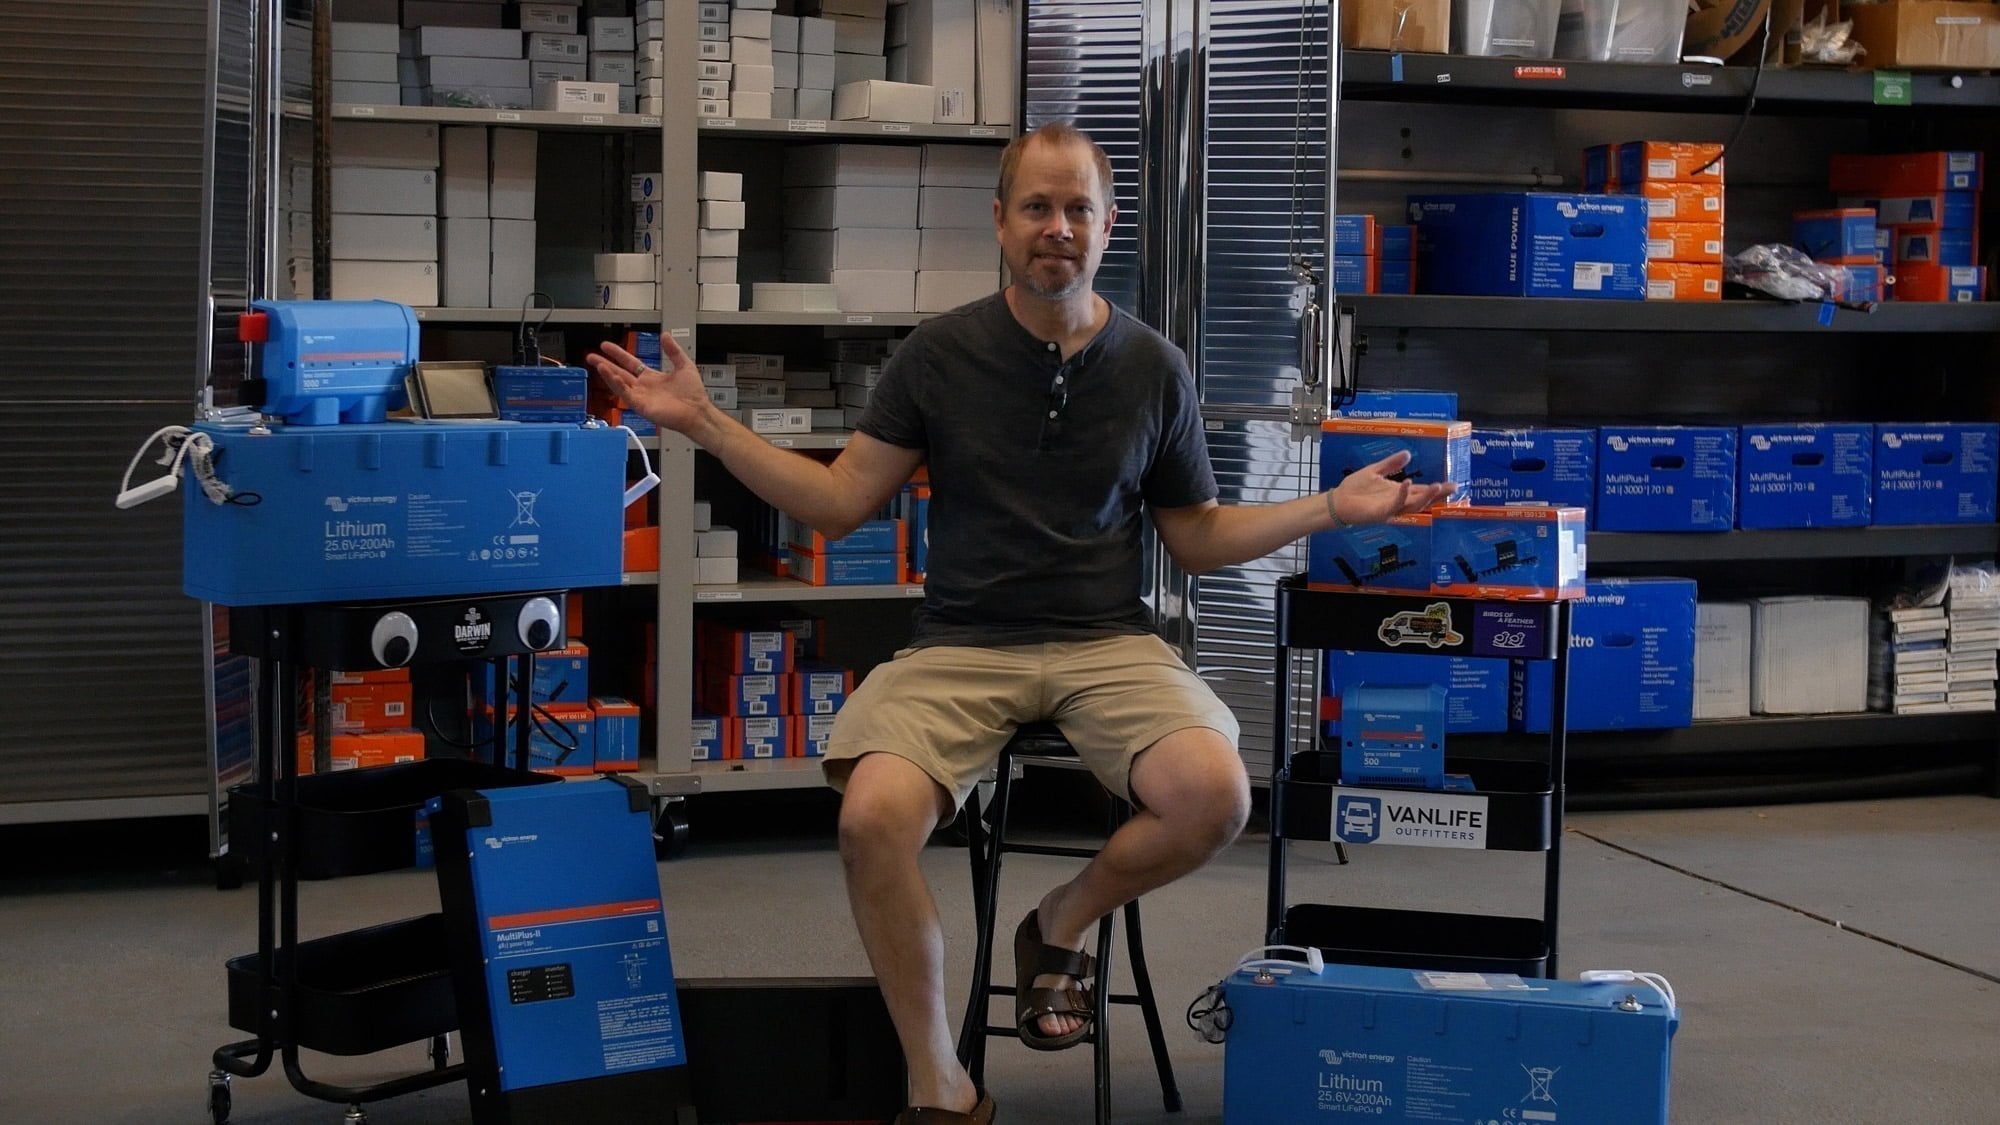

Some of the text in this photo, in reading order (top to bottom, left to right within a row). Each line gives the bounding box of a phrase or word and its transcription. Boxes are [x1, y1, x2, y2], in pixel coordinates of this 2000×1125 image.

[1577, 202, 1600, 210] victron
[1601, 204, 1624, 213] energy
[1511, 207, 1519, 250] POWER
[1348, 409, 1372, 417] victron
[1627, 436, 1675, 447] victron energy
[1769, 434, 1815, 444] victron energy
[1901, 433, 1944, 442] victron energy
[1486, 440, 1534, 449] victron energy
[1606, 474, 1649, 483] MultiPlus-II
[1750, 472, 1791, 482] MultiPlus-II
[1471, 478, 1508, 487] ultiPlus-II
[347, 495, 397, 504] victron energy
[325, 520, 387, 538] Lithium
[325, 538, 395, 551] 25.6V-200Ah
[325, 551, 347, 561] Smart
[1441, 565, 1448, 574] 5
[1597, 595, 1625, 605] energy
[454, 622, 491, 639] DARWIN
[1512, 670, 1523, 721] BLUE
[1363, 758, 1379, 766] 500
[1387, 805, 1483, 828] VANLIFE
[1395, 827, 1475, 840] OUTFITTERS
[497, 930, 541, 942] MultiPlus-II
[1342, 1051, 1395, 1063] victron energy
[1407, 1055, 1432, 1063] Caution
[1318, 1072, 1383, 1093] Lithium
[1318, 1090, 1392, 1107] 25.6V-200Ah
[1318, 1102, 1340, 1112] Smart
